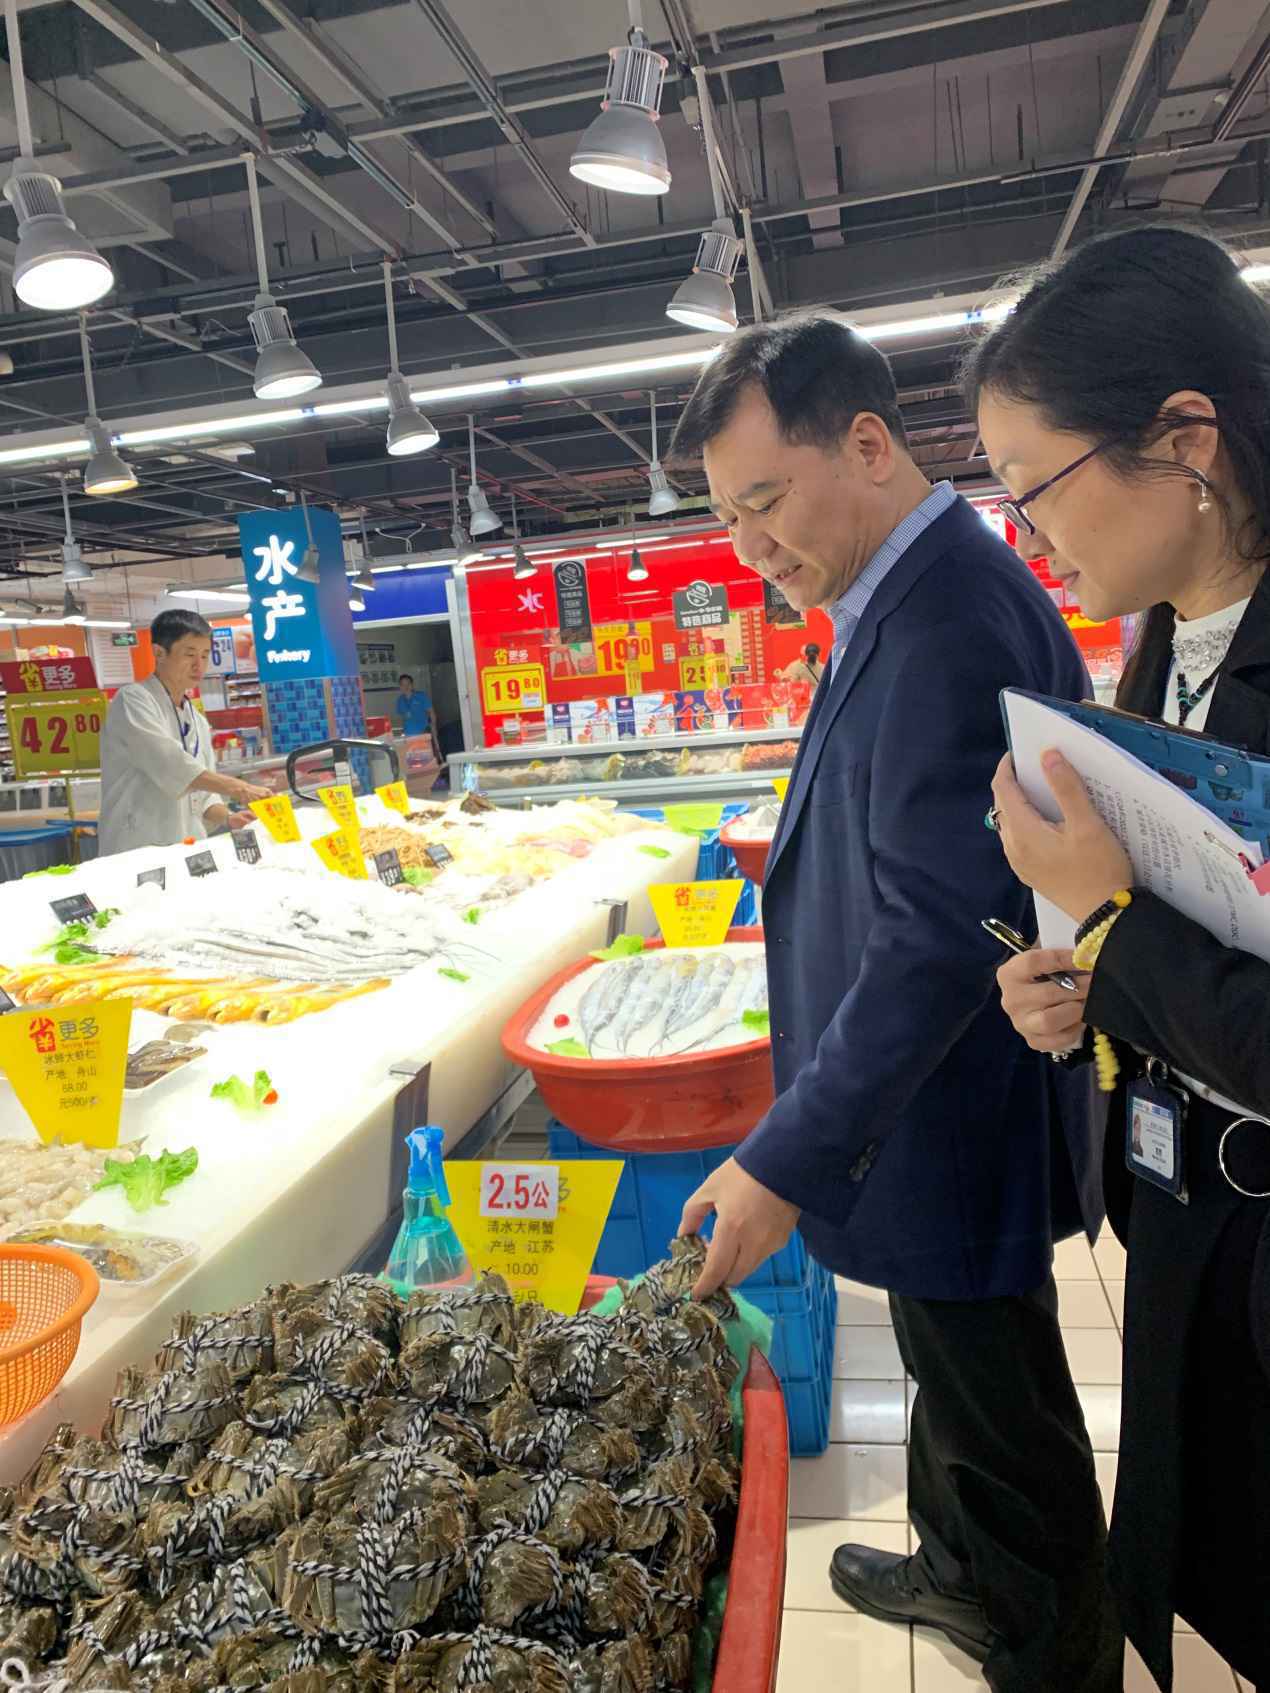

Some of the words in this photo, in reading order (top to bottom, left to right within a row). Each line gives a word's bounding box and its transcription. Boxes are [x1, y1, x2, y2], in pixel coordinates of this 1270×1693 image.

[253, 534, 306, 641] 水产
[490, 678, 521, 702] 19
[20, 715, 71, 754] 42
[74, 712, 101, 734] 80
[29, 1016, 100, 1054] 省更多
[487, 1220, 554, 1235] 清水大闸蟹
[490, 1240, 516, 1255] 产地
[527, 1240, 554, 1254] 江苏
[505, 1262, 539, 1276] 10.00
